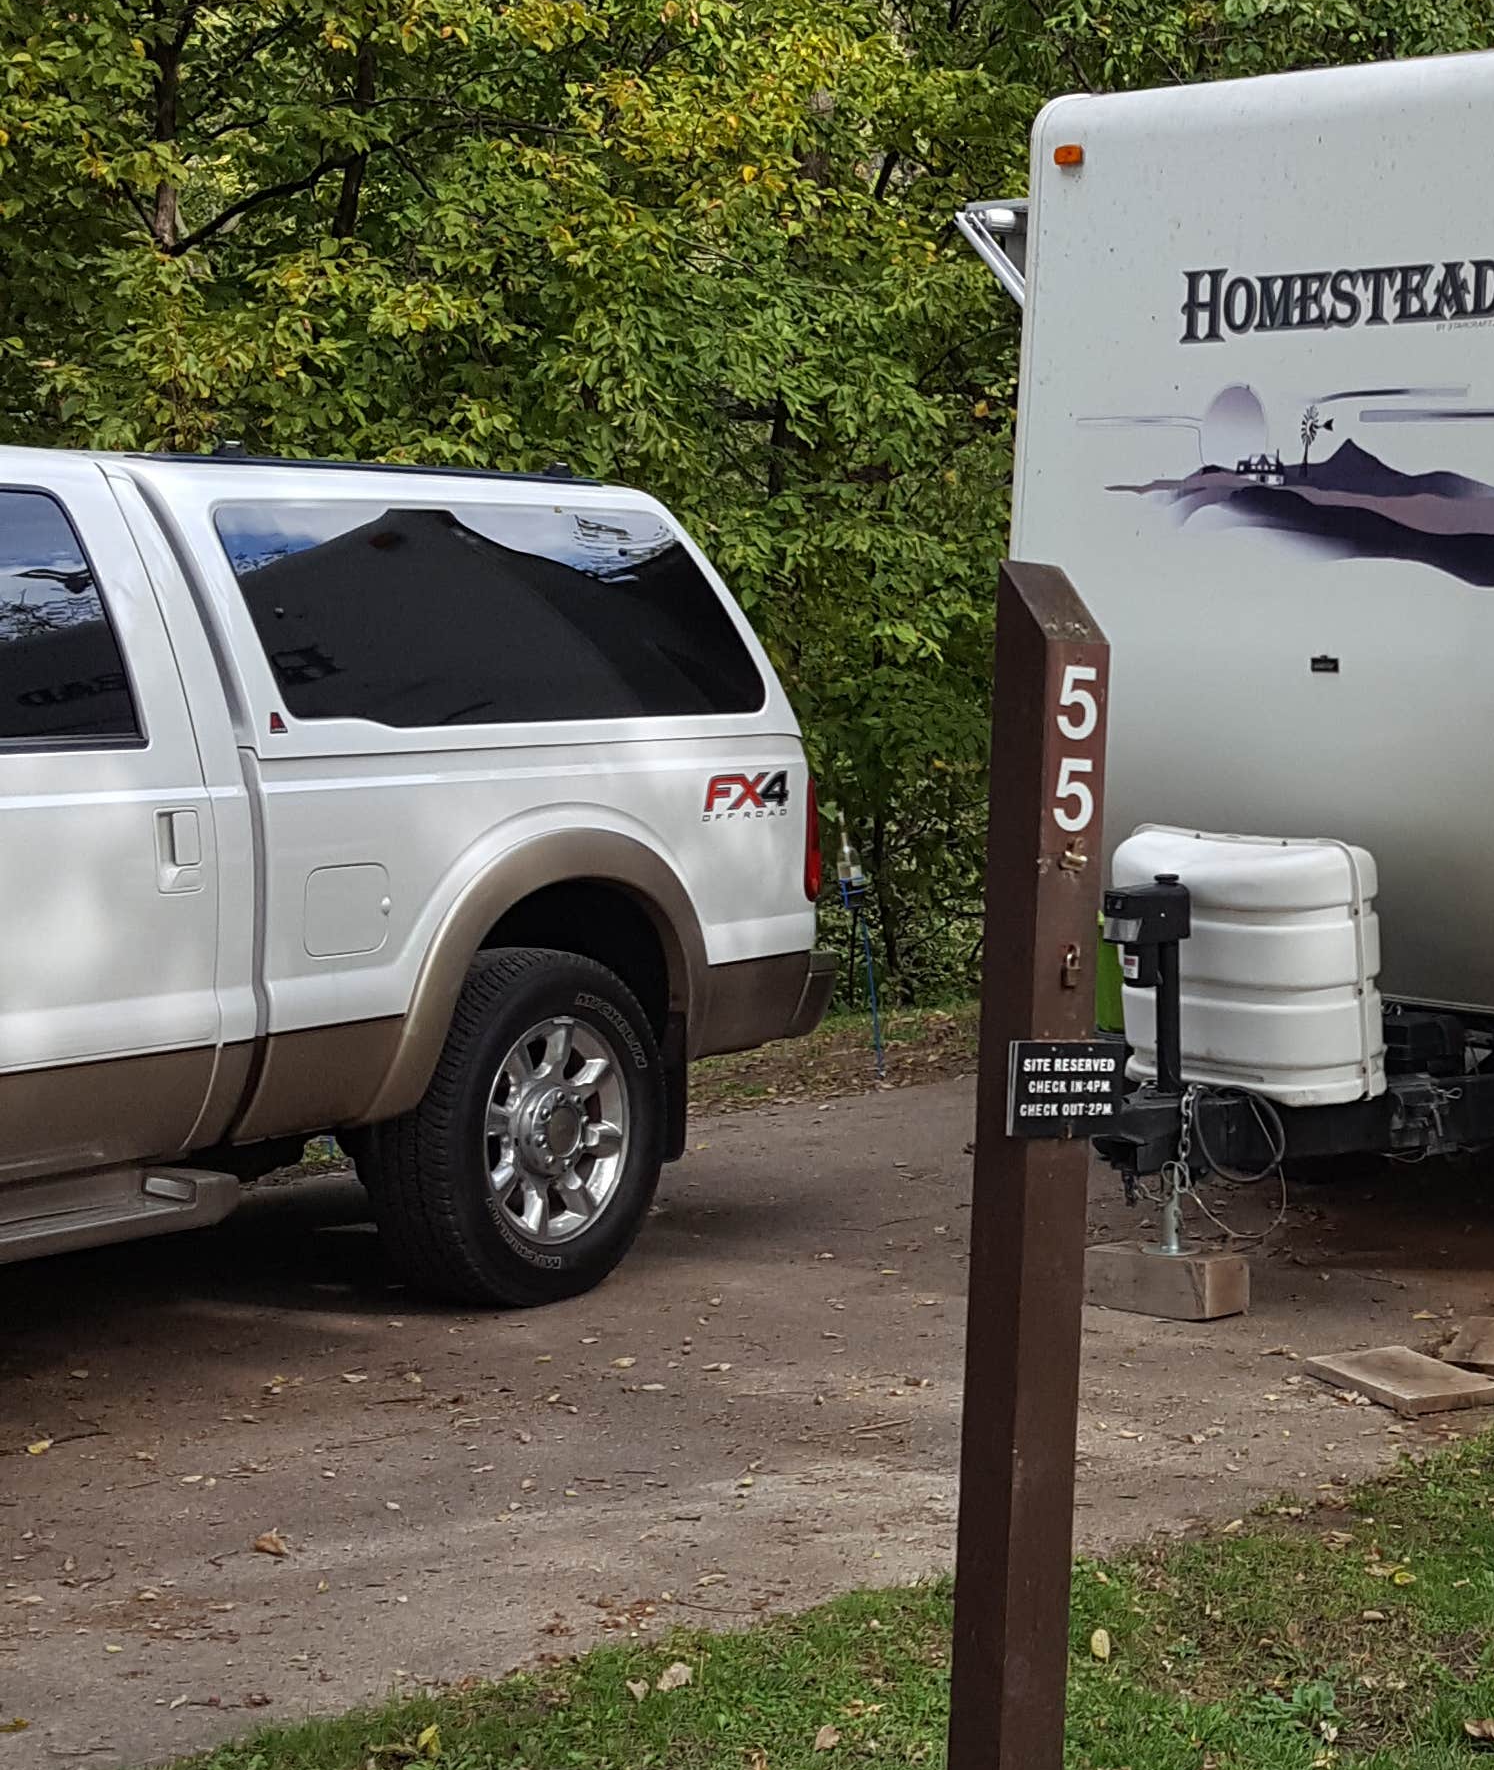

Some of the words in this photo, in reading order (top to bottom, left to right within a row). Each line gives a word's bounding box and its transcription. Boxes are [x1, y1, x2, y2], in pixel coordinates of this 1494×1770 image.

[704, 770, 789, 812] FX4
[702, 813, 735, 822] OFF
[744, 809, 787, 819] ROAD
[575, 993, 647, 1068] MICHELIN
[1023, 1058, 1052, 1072] SITE
[1053, 1058, 1116, 1072] RESERVED
[1028, 1080, 1067, 1094] CHECK
[1020, 1103, 1059, 1117] CHECK
